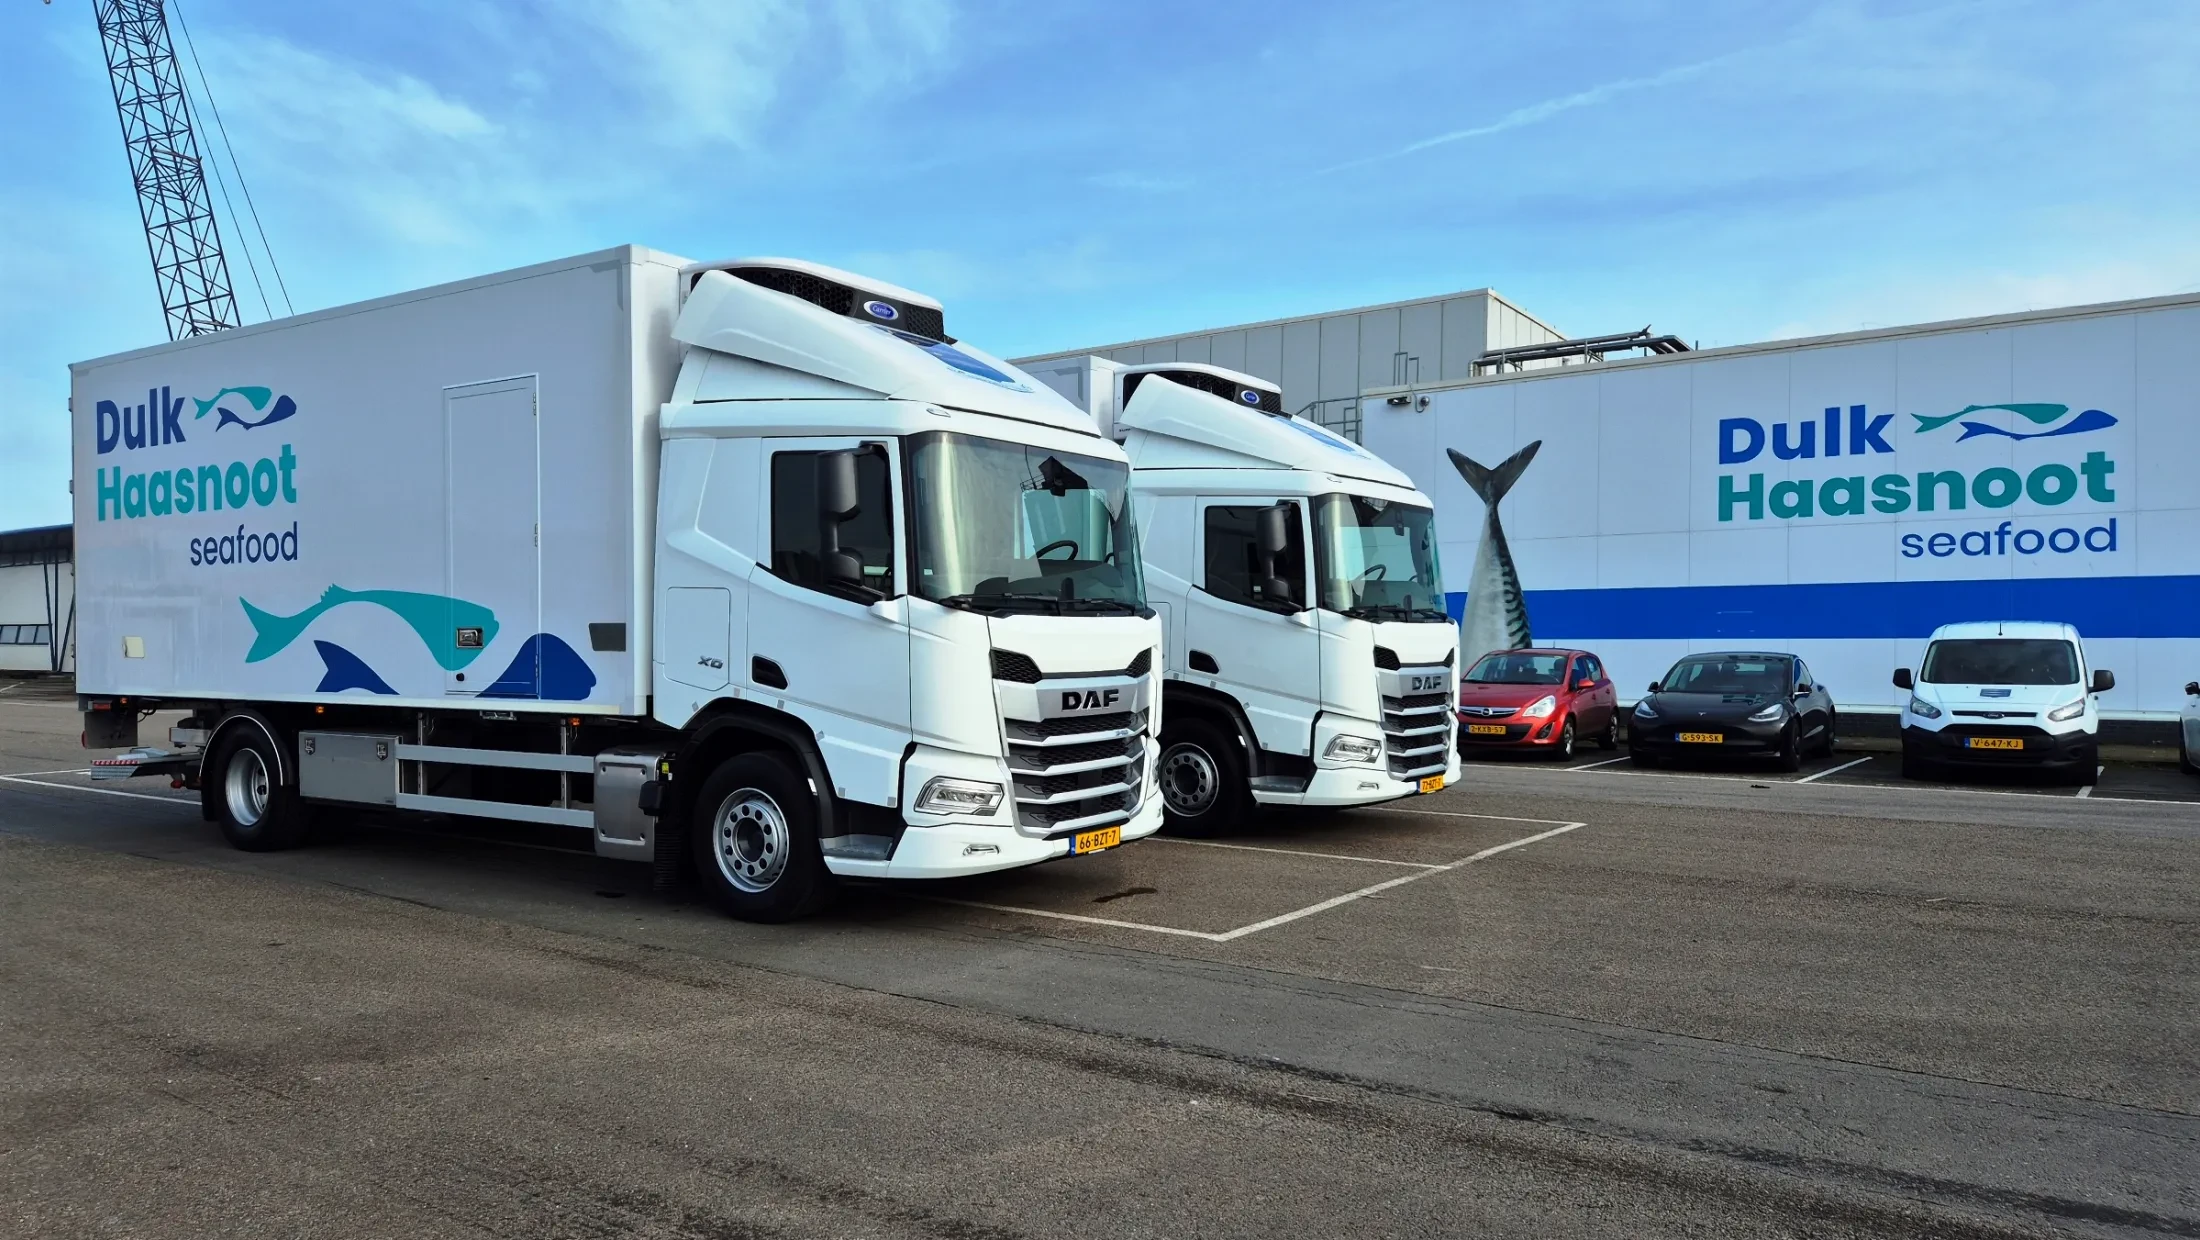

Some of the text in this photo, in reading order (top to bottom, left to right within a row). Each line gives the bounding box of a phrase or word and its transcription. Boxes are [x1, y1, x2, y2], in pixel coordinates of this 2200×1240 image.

[871, 304, 892, 316] Carrier
[96, 385, 187, 455] Dulk
[1718, 403, 1896, 466] Dulk
[96, 443, 298, 522] Haasnoot
[1717, 450, 2116, 523] Haasnoot
[190, 521, 298, 567] seafood
[1901, 517, 2118, 559] seafood
[1412, 675, 1442, 690] DAF
[1061, 688, 1119, 711] DAF
[1681, 733, 1720, 742] G-593-SK
[1973, 739, 2019, 748] V-647-KJ
[1079, 829, 1117, 850] 66-BZT-7
